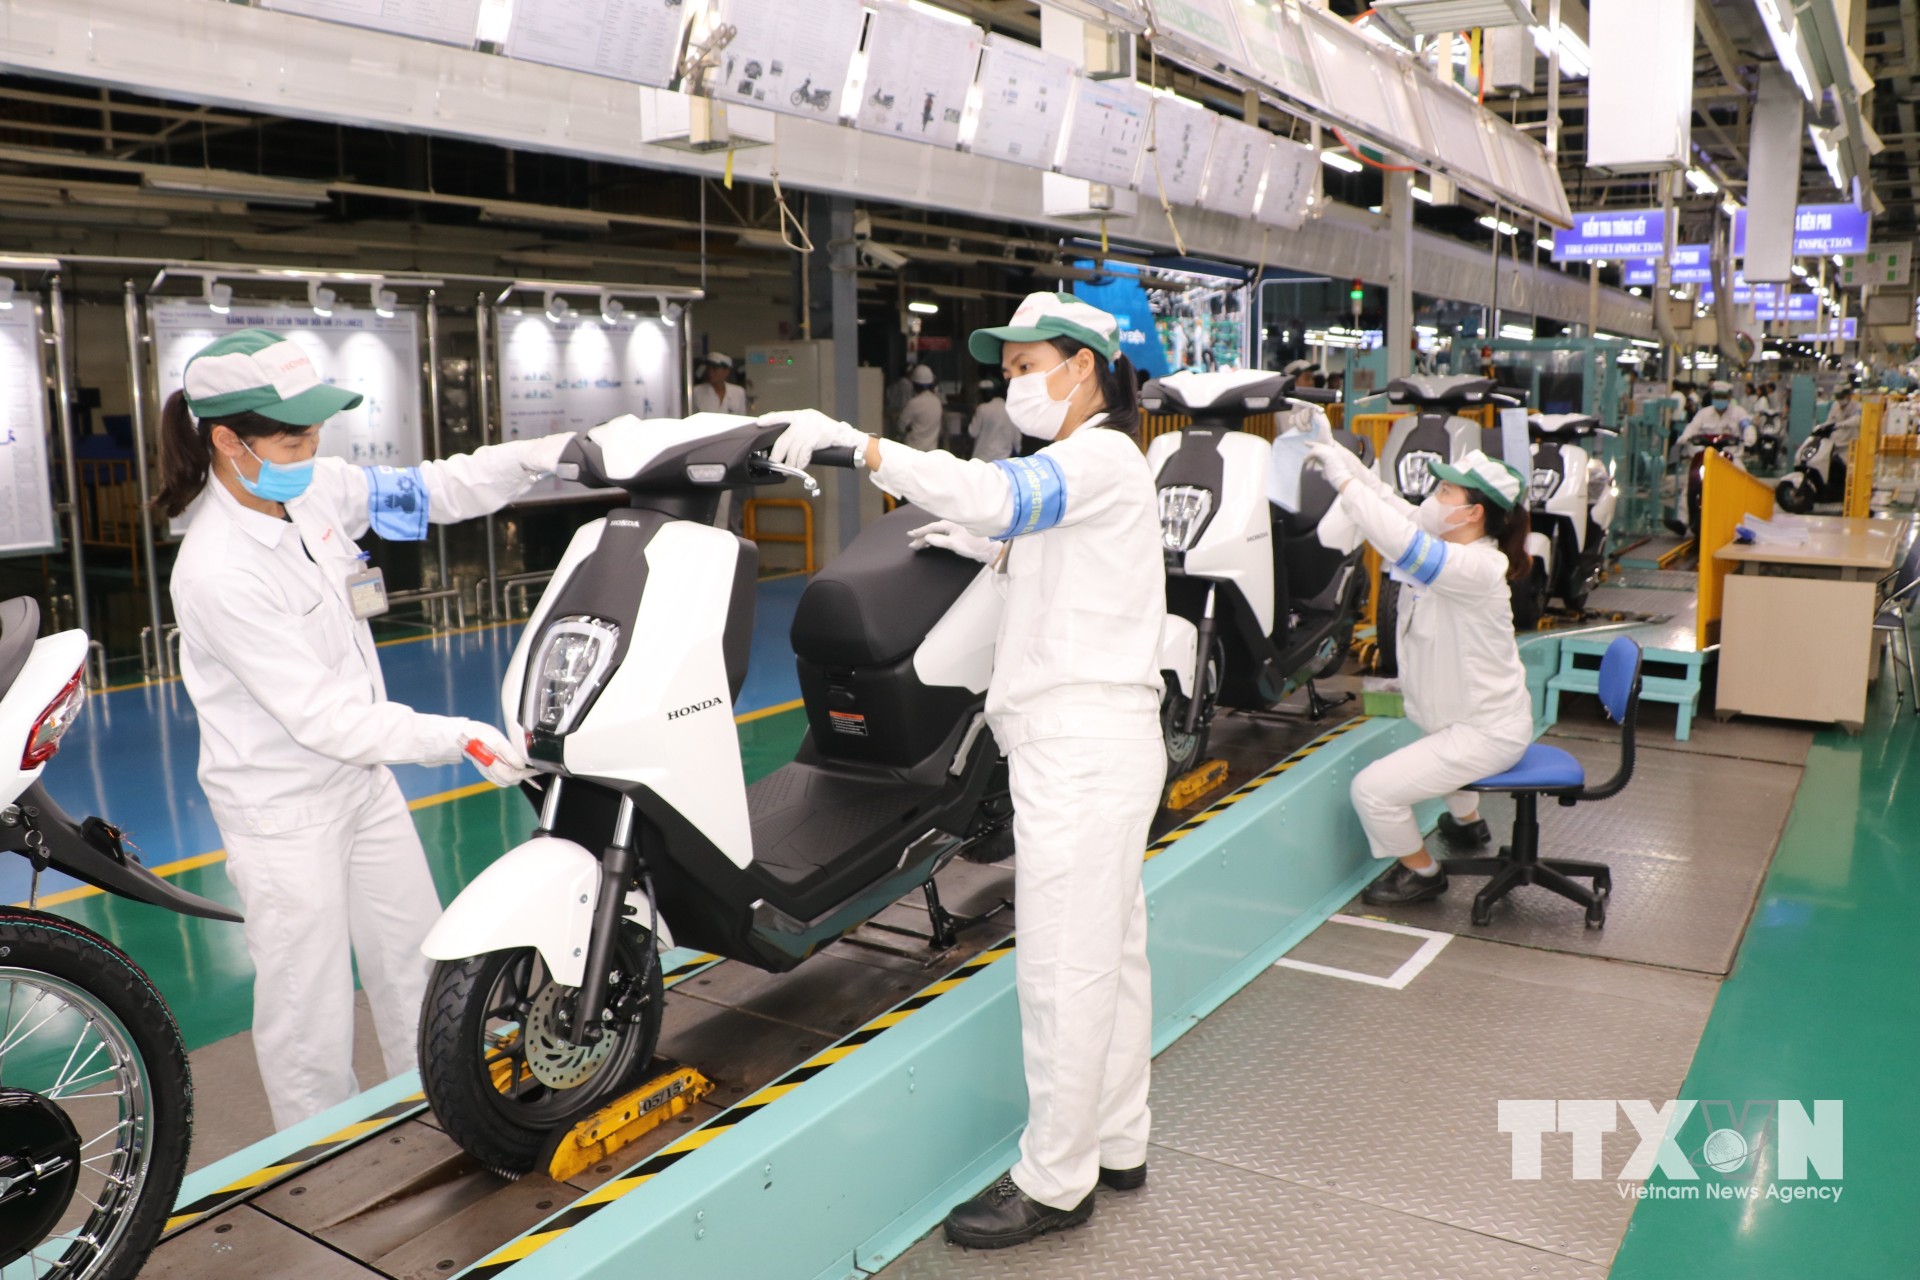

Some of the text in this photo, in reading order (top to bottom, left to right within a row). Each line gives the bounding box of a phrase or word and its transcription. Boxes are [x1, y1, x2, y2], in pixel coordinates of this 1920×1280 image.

[1565, 242, 1664, 255] TIRE OFFSET INSPECTION
[1798, 237, 1853, 250] INSPECTION
[1024, 469, 1042, 525] INSPECTION
[610, 520, 640, 528] HONDA
[666, 697, 723, 721] HONDA
[643, 1082, 681, 1111] 05/15
